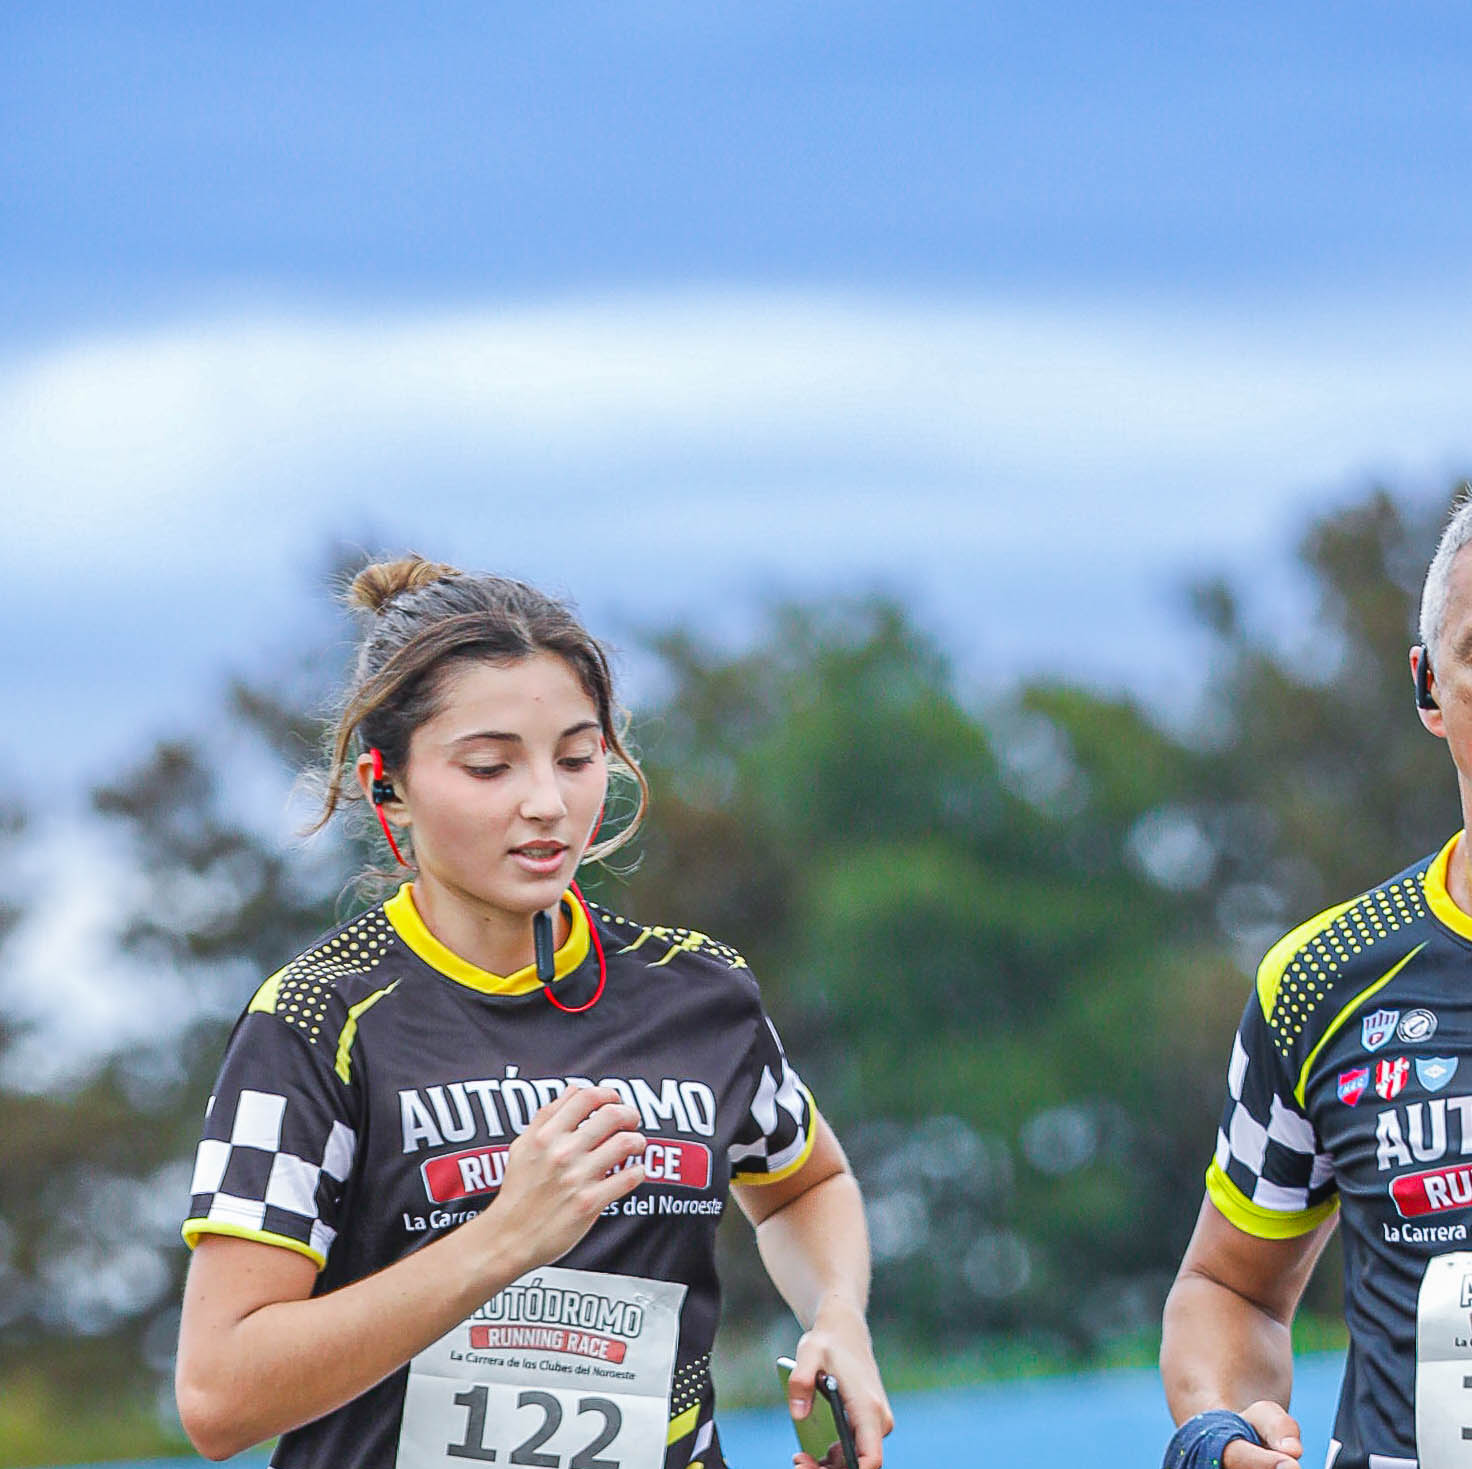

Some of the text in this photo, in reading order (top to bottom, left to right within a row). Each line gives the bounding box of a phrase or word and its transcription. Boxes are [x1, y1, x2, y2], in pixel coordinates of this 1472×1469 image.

[623, 1195, 655, 1215] del
[659, 1195, 722, 1215] Noroeste
[403, 1212, 426, 1231] La
[1383, 1223, 1400, 1242] La
[1402, 1223, 1467, 1243] Carrera
[470, 1278, 643, 1338] UTÓDROMO
[488, 1327, 610, 1359] RUNNING RACE
[1454, 1337, 1467, 1348] La
[450, 1350, 637, 1381] La Carrera de los Clubes del Noroeste
